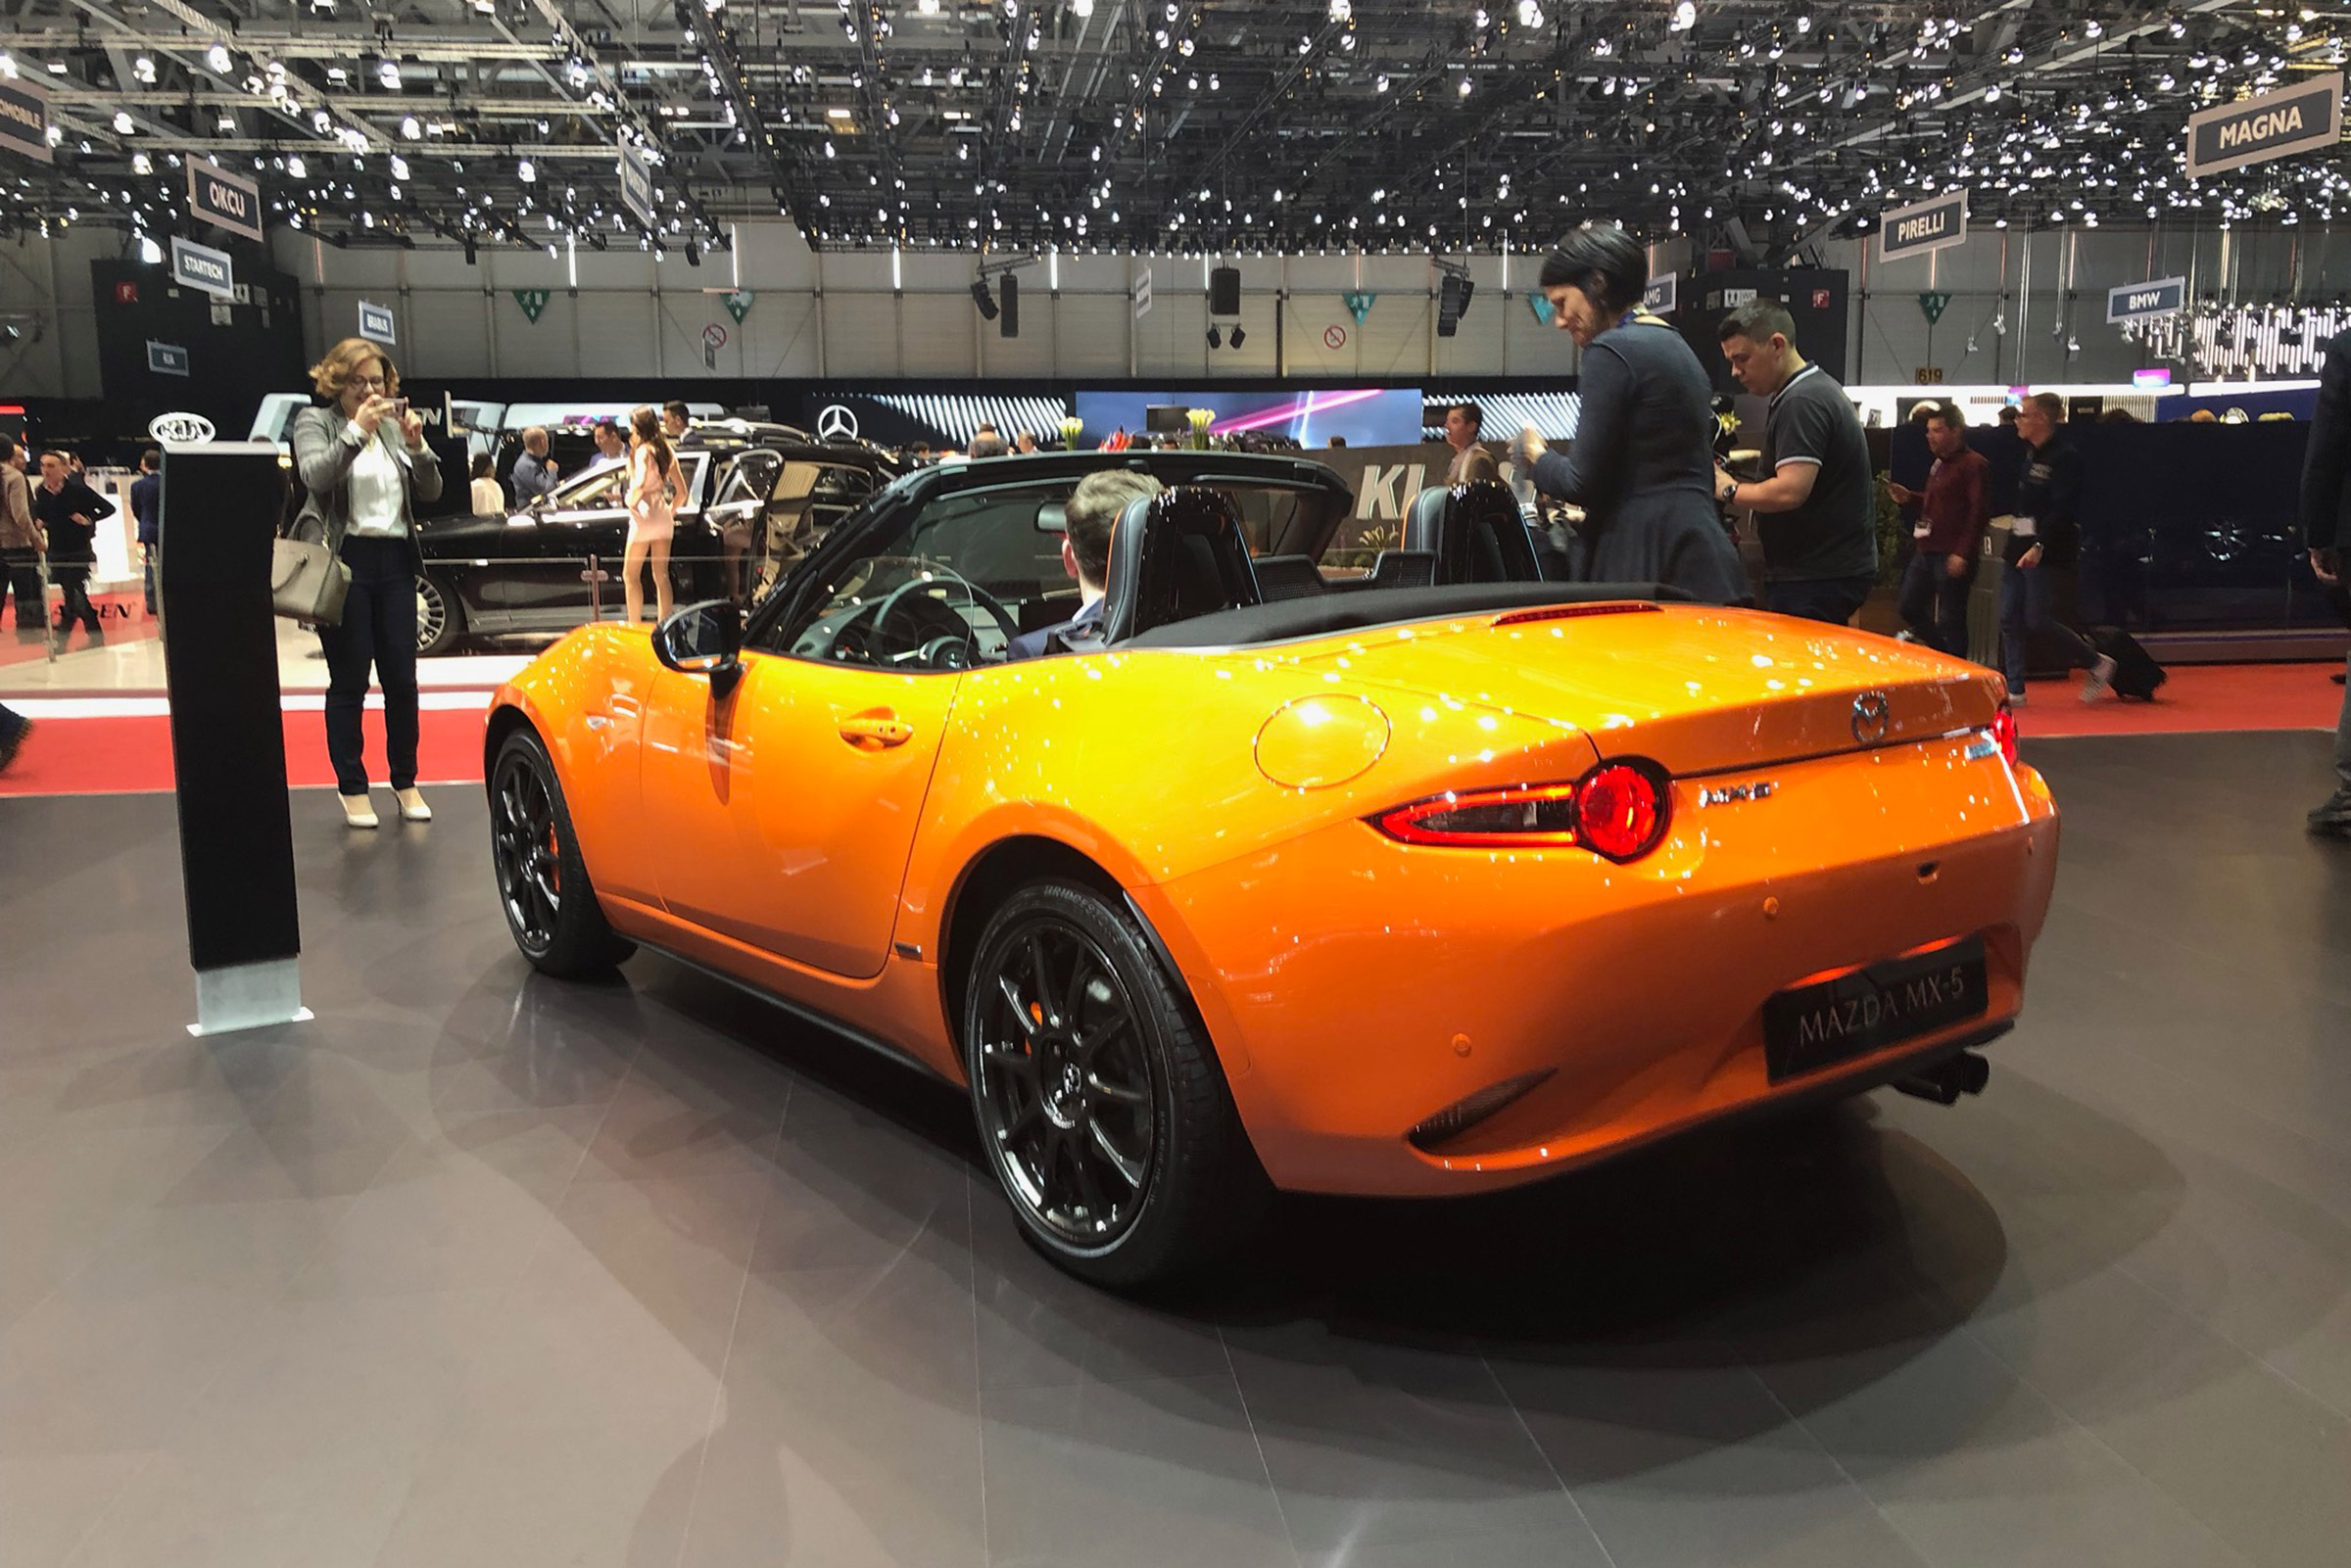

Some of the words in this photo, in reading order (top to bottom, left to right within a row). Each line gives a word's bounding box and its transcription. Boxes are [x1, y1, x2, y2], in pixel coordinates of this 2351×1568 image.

[2220, 106, 2303, 149] MAGNA
[209, 180, 245, 217] OKCU
[1897, 211, 1945, 242] PIRELLI
[2129, 292, 2161, 310] BMW
[1917, 366, 1943, 383] 619
[1799, 987, 1898, 1048] MAZDA
[1906, 966, 1964, 1013] MX-5
